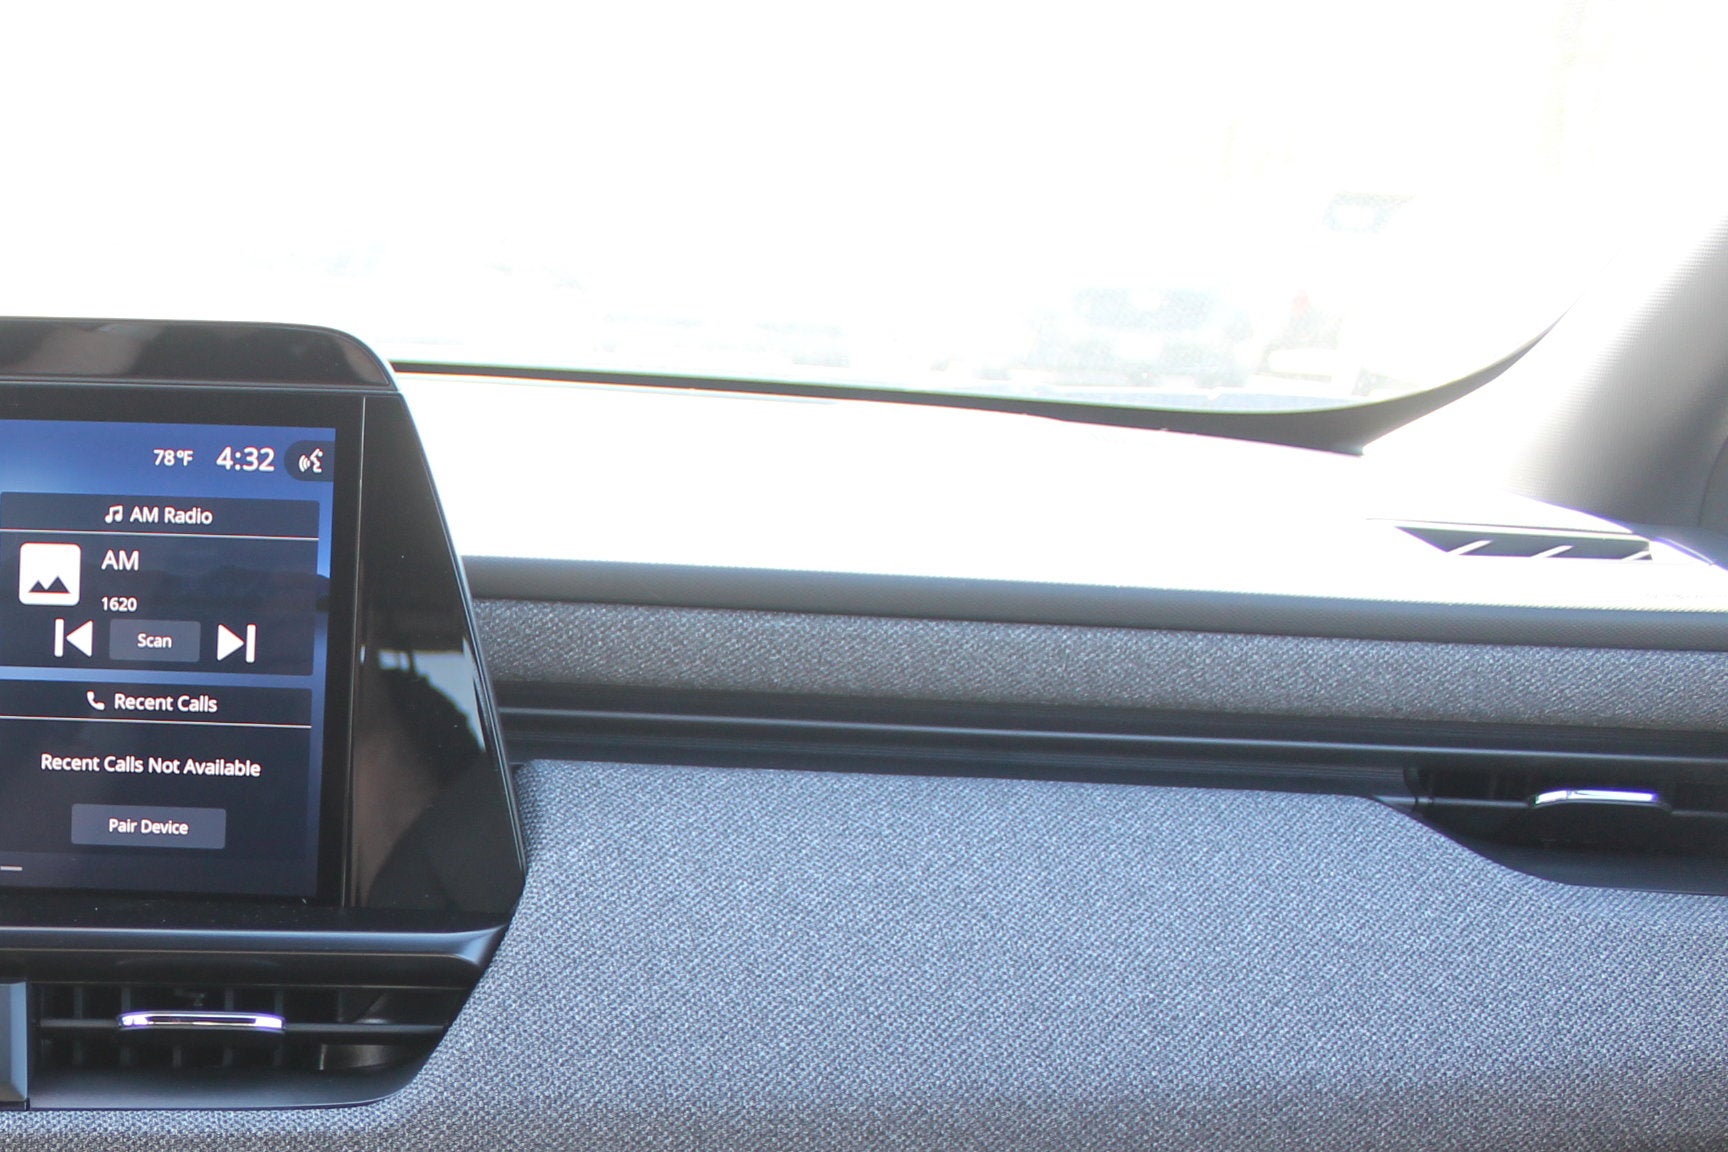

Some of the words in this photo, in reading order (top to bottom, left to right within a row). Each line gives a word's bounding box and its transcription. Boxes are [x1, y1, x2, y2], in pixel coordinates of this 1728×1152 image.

[153, 449, 194, 467] 78°F
[216, 446, 275, 472] 4:32
[129, 506, 159, 523] AM
[164, 506, 214, 525] Radio
[101, 549, 140, 571] AM
[101, 597, 138, 612] 1620
[137, 633, 173, 649] Scan
[114, 693, 173, 711] Recent
[177, 694, 218, 713] Calls
[40, 753, 100, 772] Recent
[104, 755, 144, 774] Calls
[148, 758, 180, 775] Not
[183, 758, 262, 777] Available
[108, 818, 138, 833] Pair
[141, 819, 189, 835] Device
